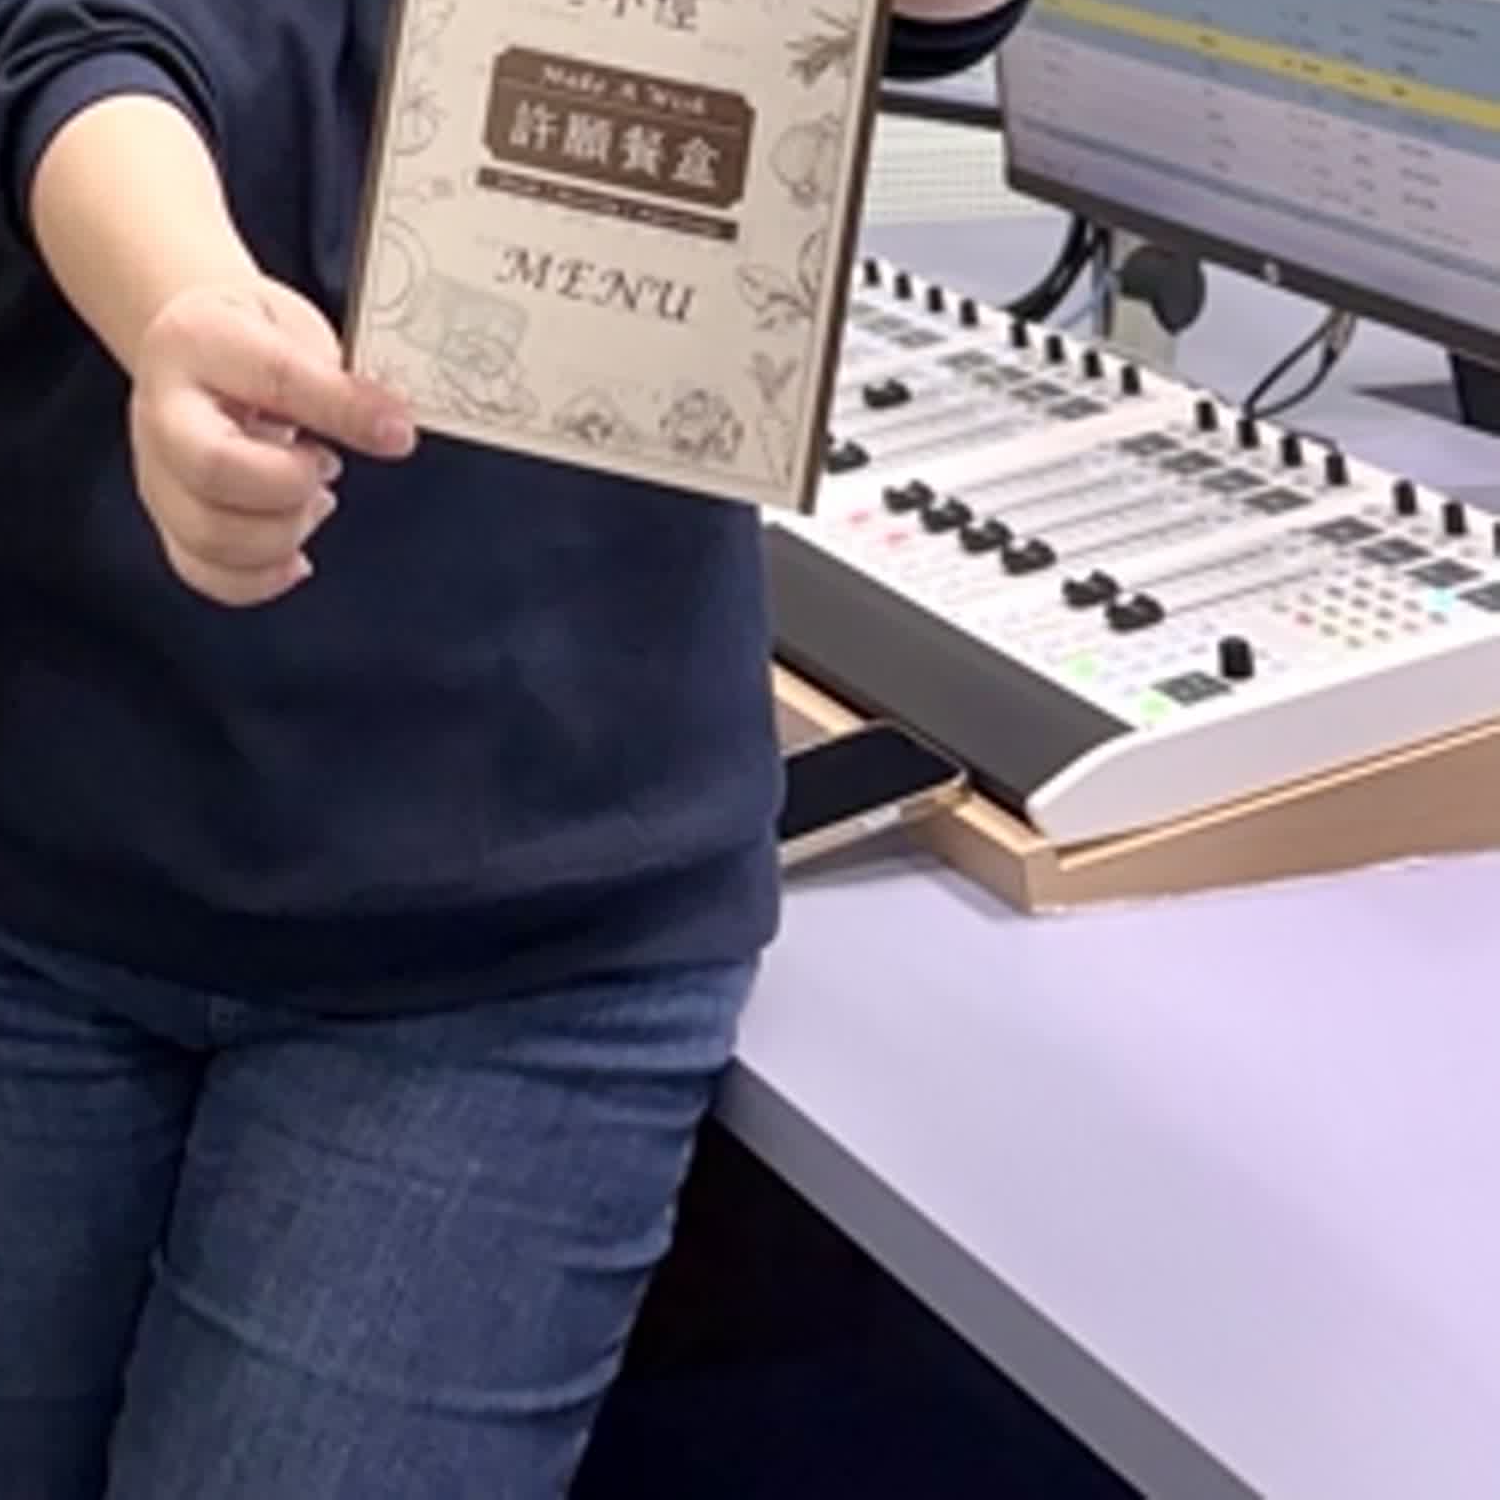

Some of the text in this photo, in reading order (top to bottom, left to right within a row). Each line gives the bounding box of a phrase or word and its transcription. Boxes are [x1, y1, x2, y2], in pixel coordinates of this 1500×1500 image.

[507, 98, 722, 188] 許願餐盒
[493, 246, 696, 322] MENU
